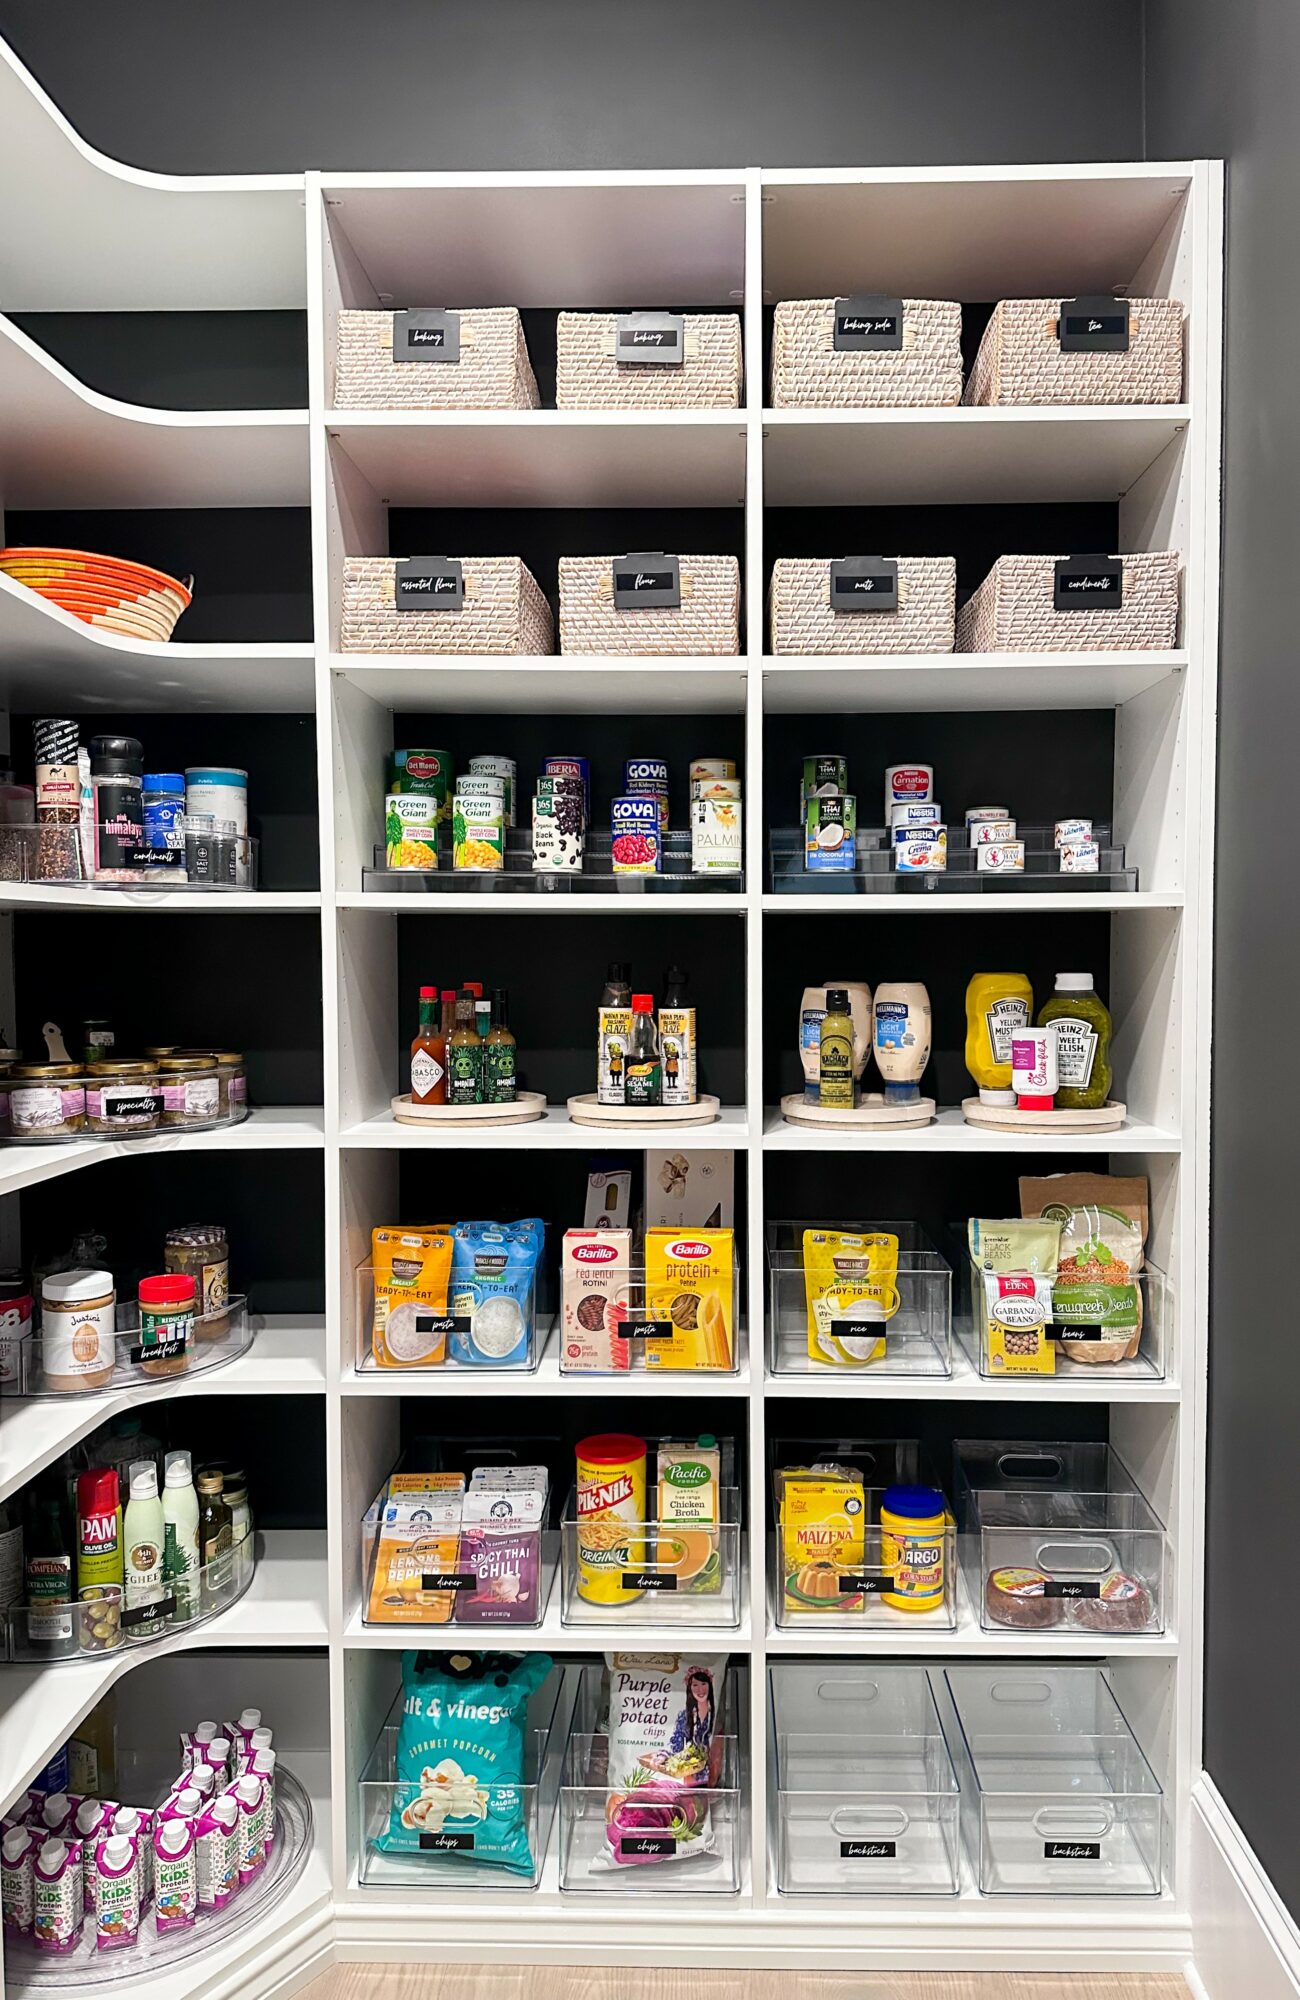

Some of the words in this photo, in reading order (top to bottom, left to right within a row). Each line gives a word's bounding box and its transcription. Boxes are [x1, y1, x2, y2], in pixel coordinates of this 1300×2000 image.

[843, 319, 873, 333] baking
[874, 318, 891, 329] soda
[1087, 319, 1102, 331] tea
[413, 330, 443, 345] baking
[633, 331, 664, 344] baking
[401, 577, 431, 591] assorted
[434, 577, 456, 592] flour
[634, 574, 656, 589] flour
[855, 580, 873, 591] nuts
[1068, 577, 1111, 592] condiments
[548, 765, 578, 774] IBERIA
[629, 764, 667, 778] GOYA
[818, 765, 836, 773] THAI
[462, 781, 488, 789] Green
[540, 781, 552, 790] 365
[893, 774, 929, 787] Carnation
[398, 800, 427, 809] Green
[462, 800, 491, 808] Green
[537, 800, 550, 810] 365
[613, 803, 654, 817] GOYA
[116, 814, 127, 822] pink
[401, 809, 427, 818] Giant
[465, 809, 491, 817] Giant
[134, 850, 175, 863] condiments
[1000, 1005, 1023, 1013] HEINZ
[1000, 1019, 1021, 1027] YELLOW
[605, 1025, 628, 1034] GLAZE
[1058, 1045, 1084, 1053] ELISH
[411, 1068, 440, 1077] ABASCO
[116, 1098, 157, 1112] specialty
[675, 1244, 709, 1255] Barilla
[984, 1243, 1012, 1251] BLACK
[577, 1248, 613, 1259] Barilla
[984, 1251, 1012, 1259] BEANS
[576, 1269, 590, 1279] red
[667, 1263, 711, 1280] protein
[819, 1286, 883, 1295] RADY-TO-EAT
[1004, 1281, 1029, 1290] EDEN
[1056, 1299, 1105, 1313] enugreek
[71, 1314, 101, 1326] Justin's
[162, 1314, 188, 1323] REDUCED
[1006, 1315, 1034, 1323] BEANS
[432, 1320, 455, 1332] pasta
[633, 1324, 657, 1337] pasta
[1062, 1326, 1085, 1338] beans
[141, 1342, 179, 1358] breakfast
[669, 1465, 707, 1479] Pacific
[675, 1509, 700, 1517] Broth
[81, 1515, 116, 1541] PAM
[797, 1530, 853, 1545] MAIZENA
[504, 1547, 530, 1560] THAI
[906, 1549, 938, 1564] ARGO
[479, 1560, 520, 1579] CHILI
[44, 1580, 67, 1588] VIRGIN
[130, 1573, 159, 1583] GHEE
[436, 1576, 463, 1588] dinner
[637, 1575, 663, 1587] dinner
[857, 1580, 876, 1589] misc
[1062, 1586, 1082, 1595] misc
[143, 1605, 157, 1617] oils
[619, 1654, 644, 1667] Wai
[617, 1673, 671, 1694] Purple
[622, 1696, 669, 1710] sweet
[404, 1696, 422, 1716] alt
[426, 1698, 441, 1717] &
[447, 1700, 513, 1724] vinega
[619, 1710, 668, 1727] potato
[643, 1727, 666, 1737] chips
[617, 1739, 648, 1747] ROSEMARY
[408, 1738, 448, 1758] GOURMET
[453, 1738, 497, 1762] POPCORN
[497, 1789, 515, 1799] 35
[490, 1798, 519, 1807] CALORIES
[435, 1835, 459, 1847] chips
[637, 1840, 661, 1852] chips
[849, 1843, 889, 1856] backstock
[1052, 1844, 1093, 1857] backstock
[160, 1860, 189, 1873] Orgain
[36, 1882, 62, 1892] Orgain
[102, 1877, 131, 1889] Orgain
[160, 1879, 189, 1889] Protein
[102, 1895, 131, 1906] Protein
